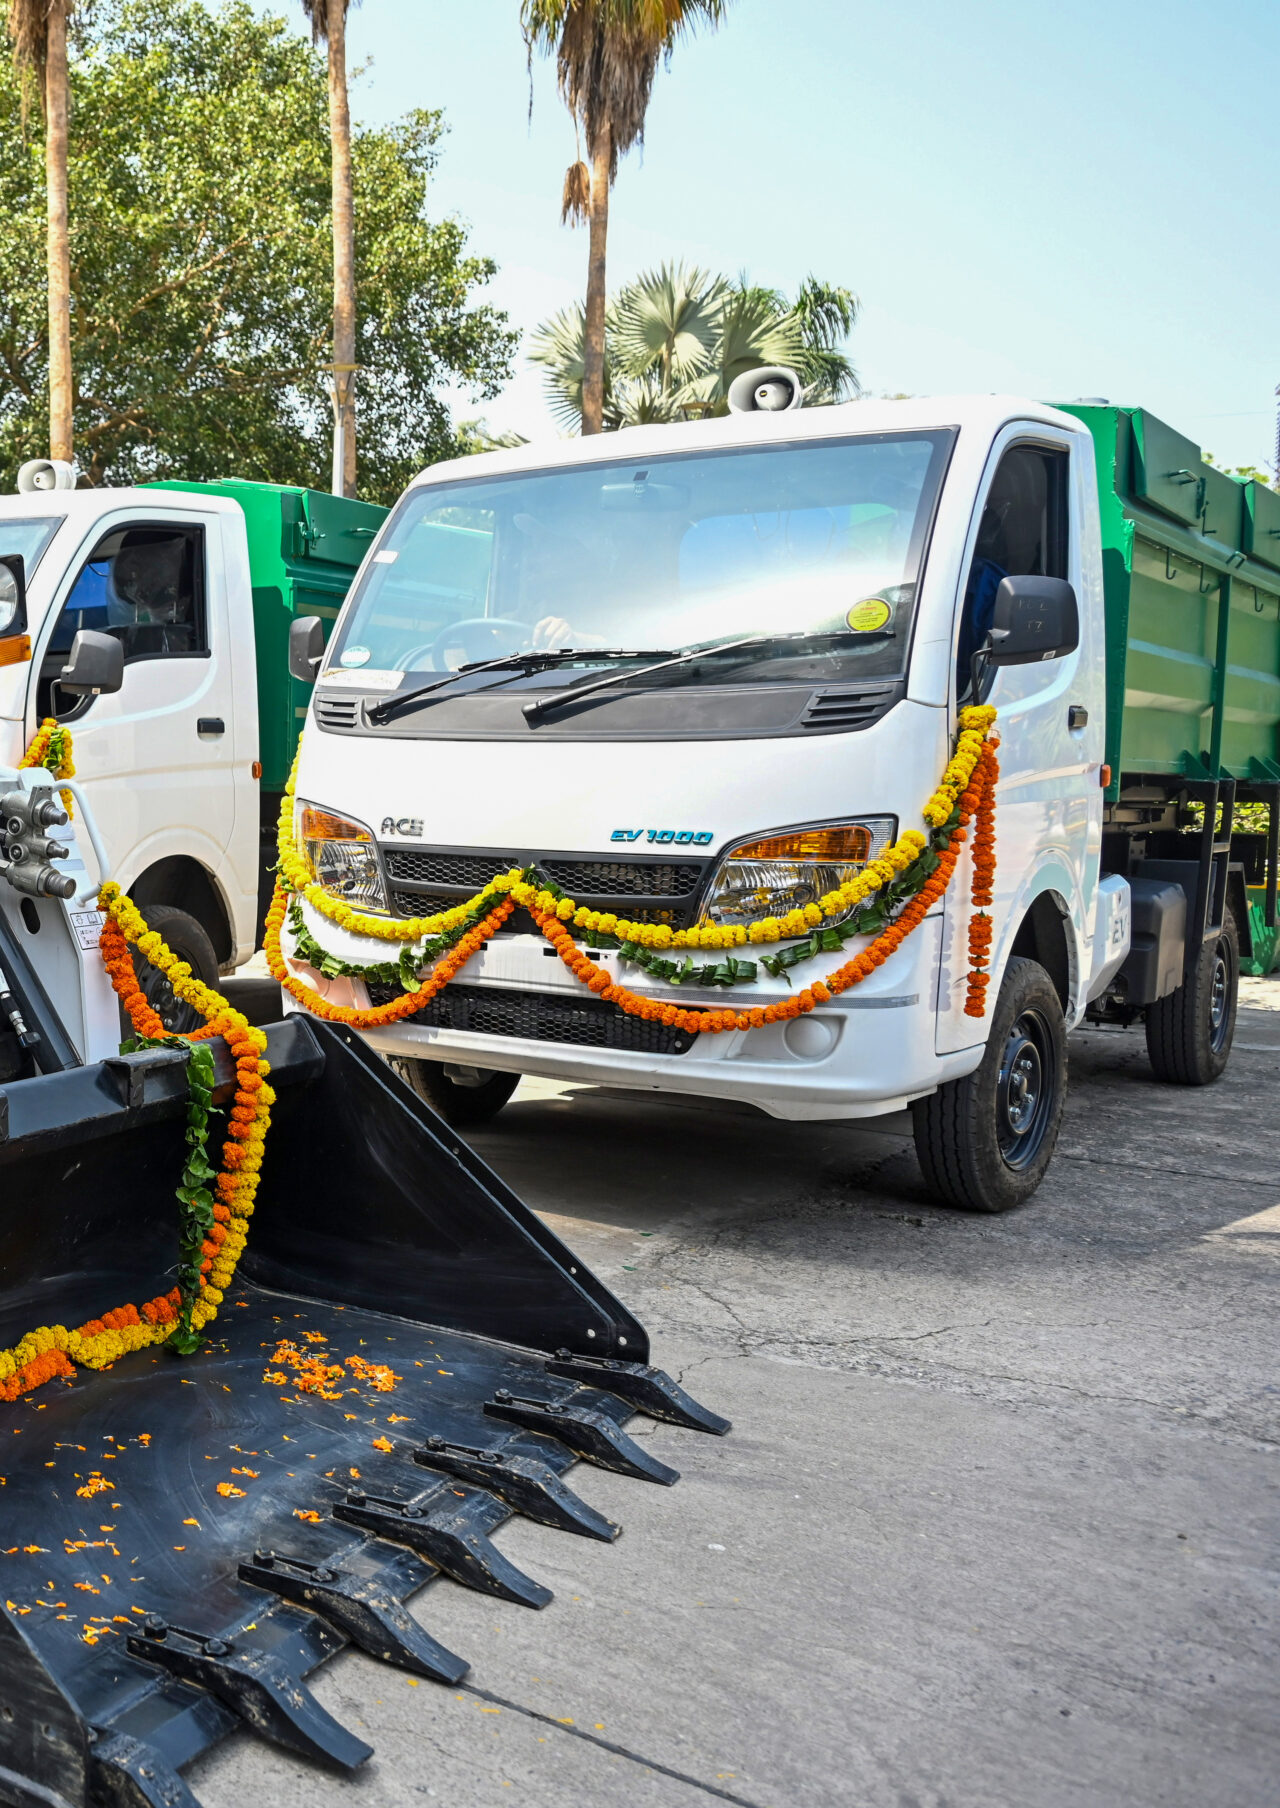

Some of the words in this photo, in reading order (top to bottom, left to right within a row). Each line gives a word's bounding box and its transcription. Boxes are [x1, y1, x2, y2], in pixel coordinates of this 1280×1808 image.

[381, 816, 425, 837] ACE
[610, 829, 644, 843] EV
[647, 829, 714, 846] 1000
